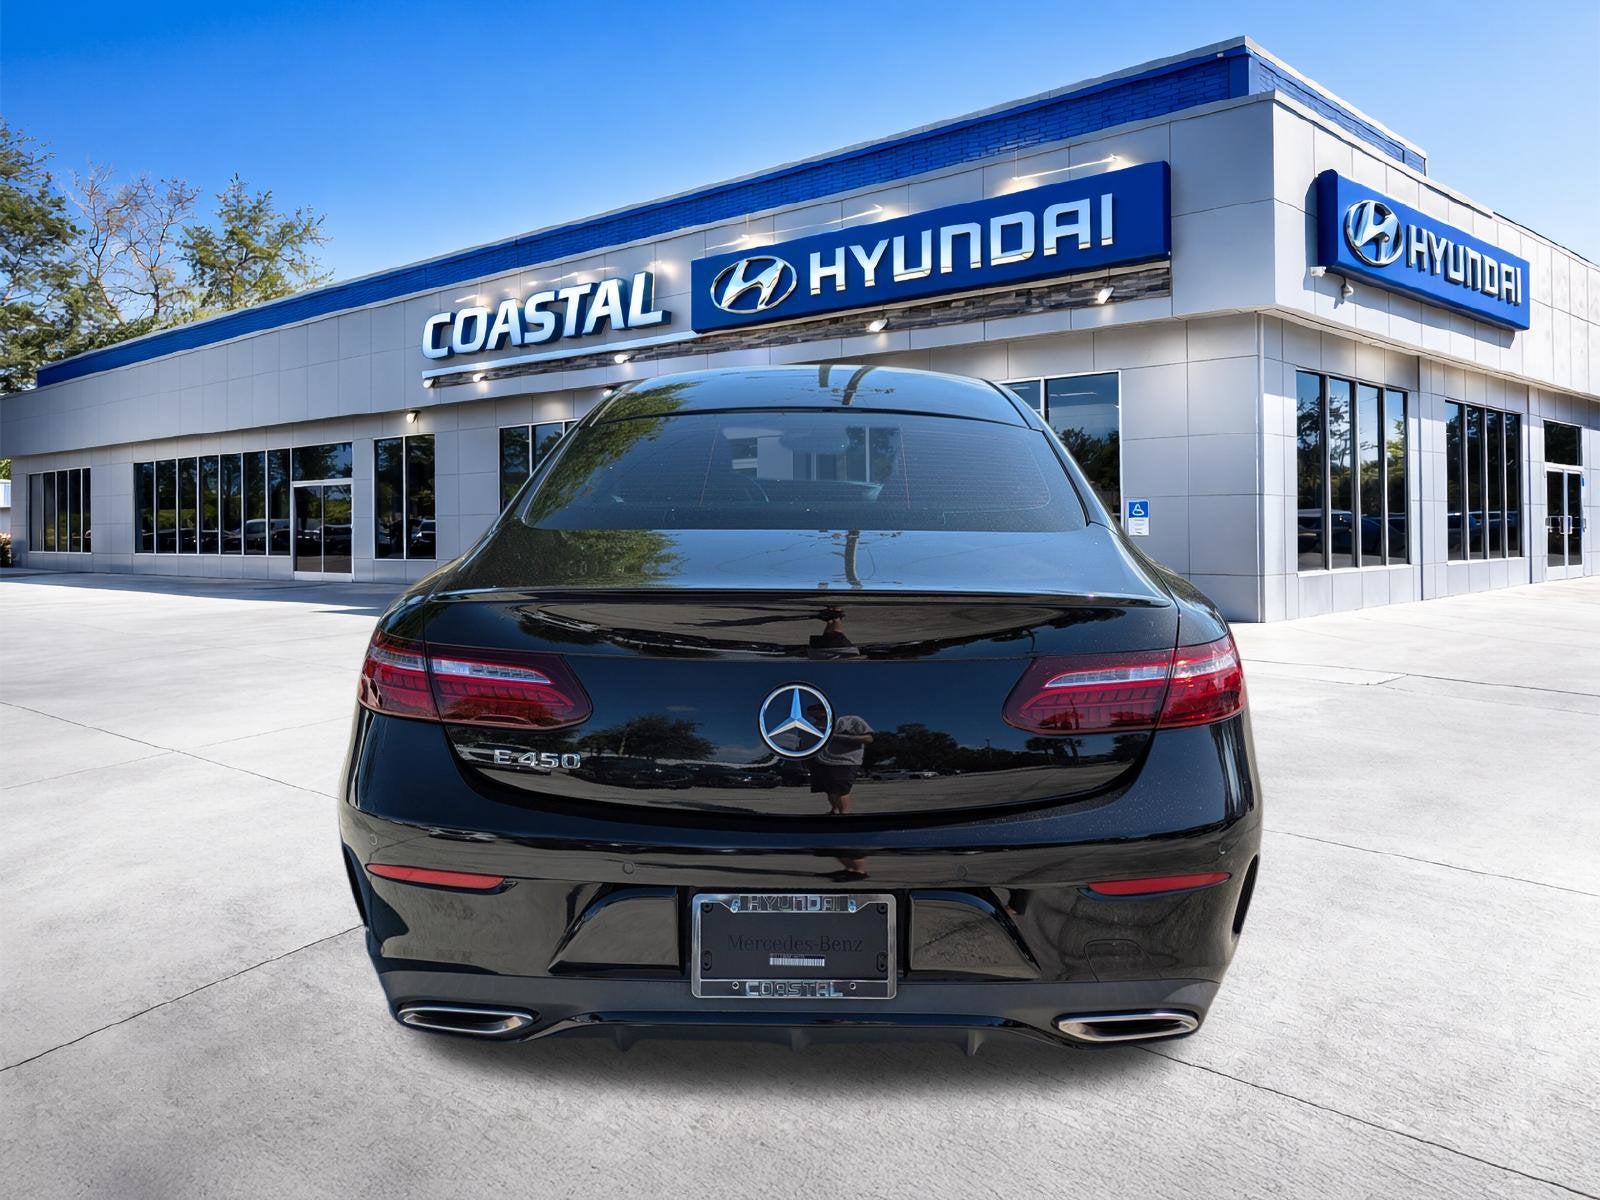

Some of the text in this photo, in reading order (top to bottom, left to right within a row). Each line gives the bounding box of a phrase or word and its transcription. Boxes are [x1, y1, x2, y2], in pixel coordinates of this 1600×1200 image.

[808, 193, 1114, 296] HYUNDAI
[1407, 225, 1522, 306] HYUNDAI
[421, 270, 669, 361] COASTAL
[517, 751, 581, 769] 450
[748, 895, 841, 912] HYUNDAI
[745, 981, 843, 998] COASTAL
